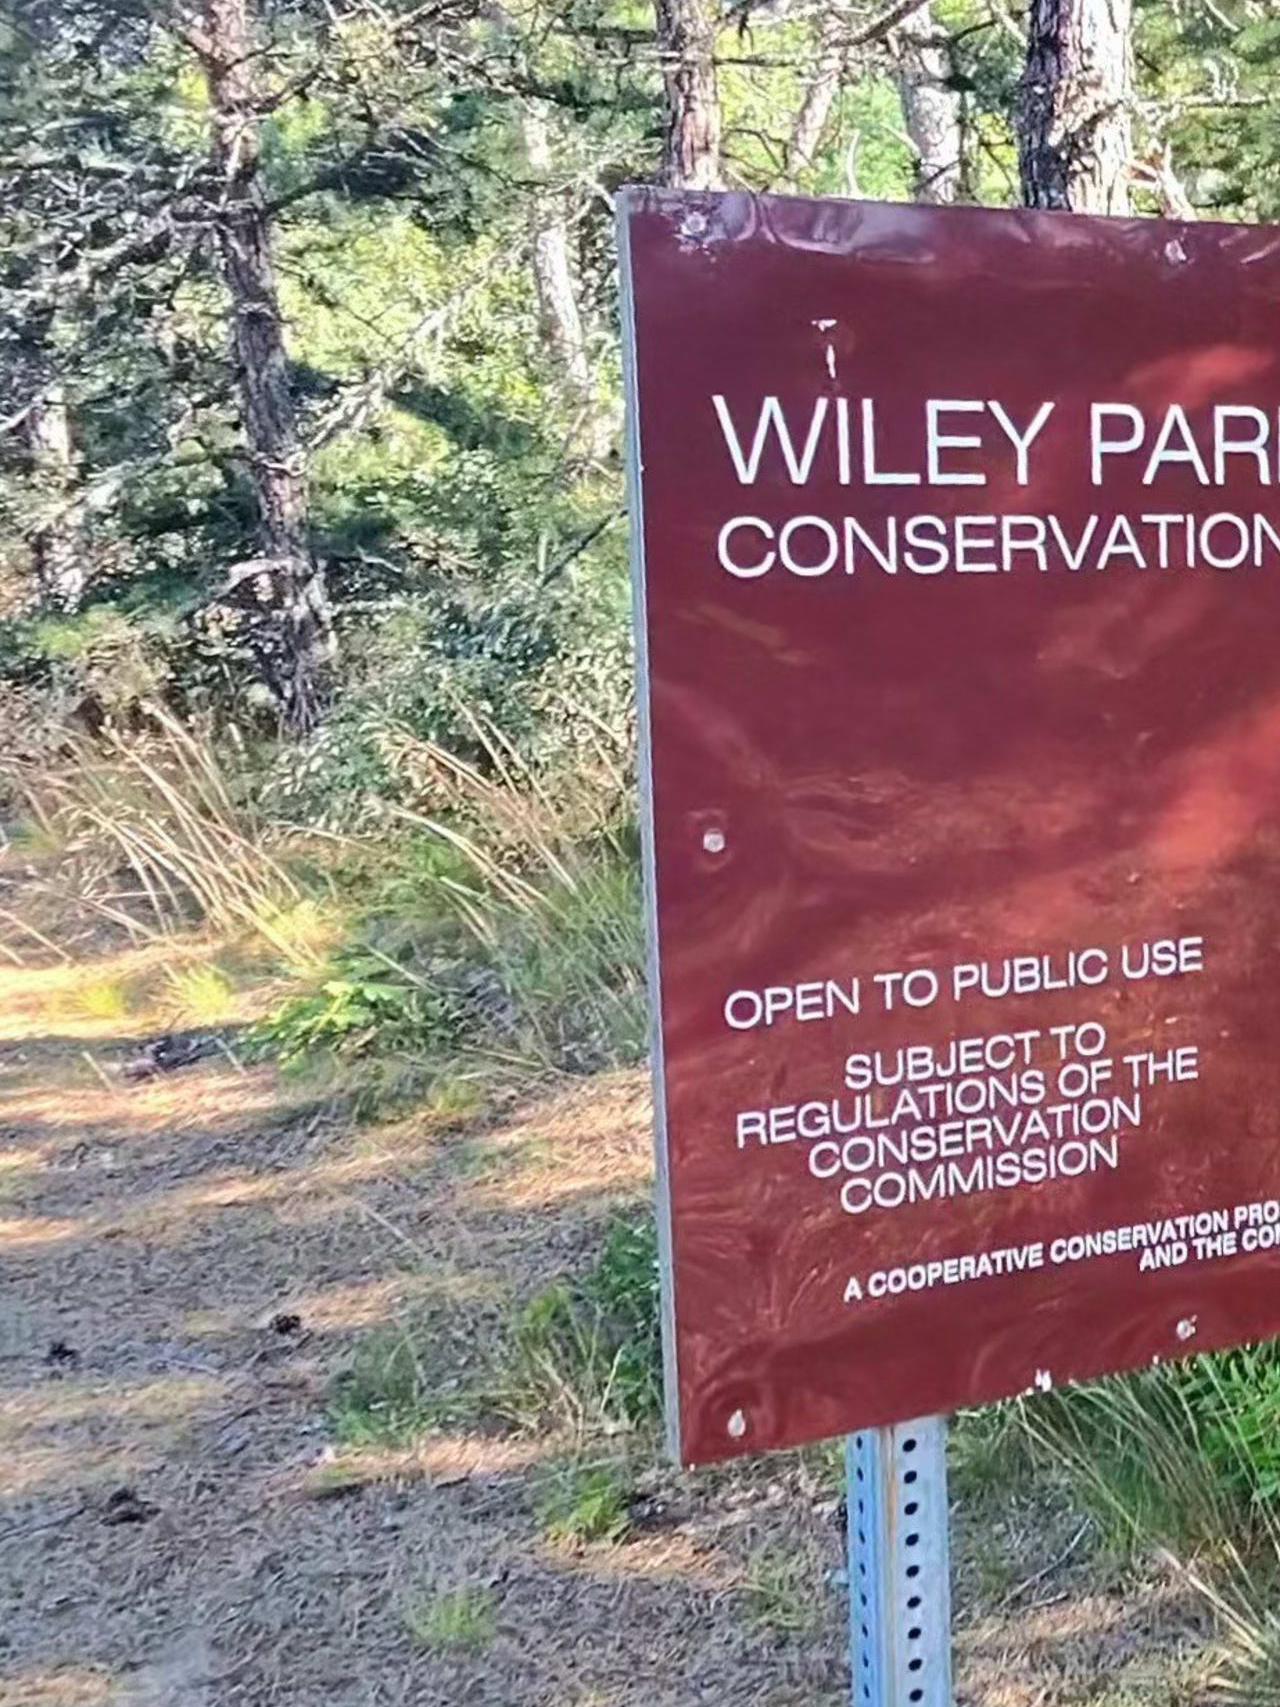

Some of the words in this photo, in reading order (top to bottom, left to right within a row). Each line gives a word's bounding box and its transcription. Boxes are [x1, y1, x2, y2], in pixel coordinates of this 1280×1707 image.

[712, 394, 1056, 486] WILEY
[724, 977, 860, 1030] OPEN
[873, 970, 939, 1010] TO
[953, 949, 1108, 1001] PUBLIC
[1121, 937, 1204, 979] USE
[736, 1069, 1046, 1149] REGULATIONS
[1057, 1060, 1113, 1097] OF
[1123, 1047, 1199, 1088] THE
[844, 1030, 1041, 1090] SUBJECT
[1050, 1022, 1107, 1061] TO
[807, 1094, 1142, 1178] CONSERVATION
[839, 1135, 1119, 1215] COMMISSION
[842, 1276, 863, 1303] A
[867, 1242, 1045, 1299] COOPERATIVE
[1050, 1210, 1229, 1264] CONSERVATION
[1138, 1241, 1188, 1272] AND
[1193, 1229, 1238, 1261] THE
